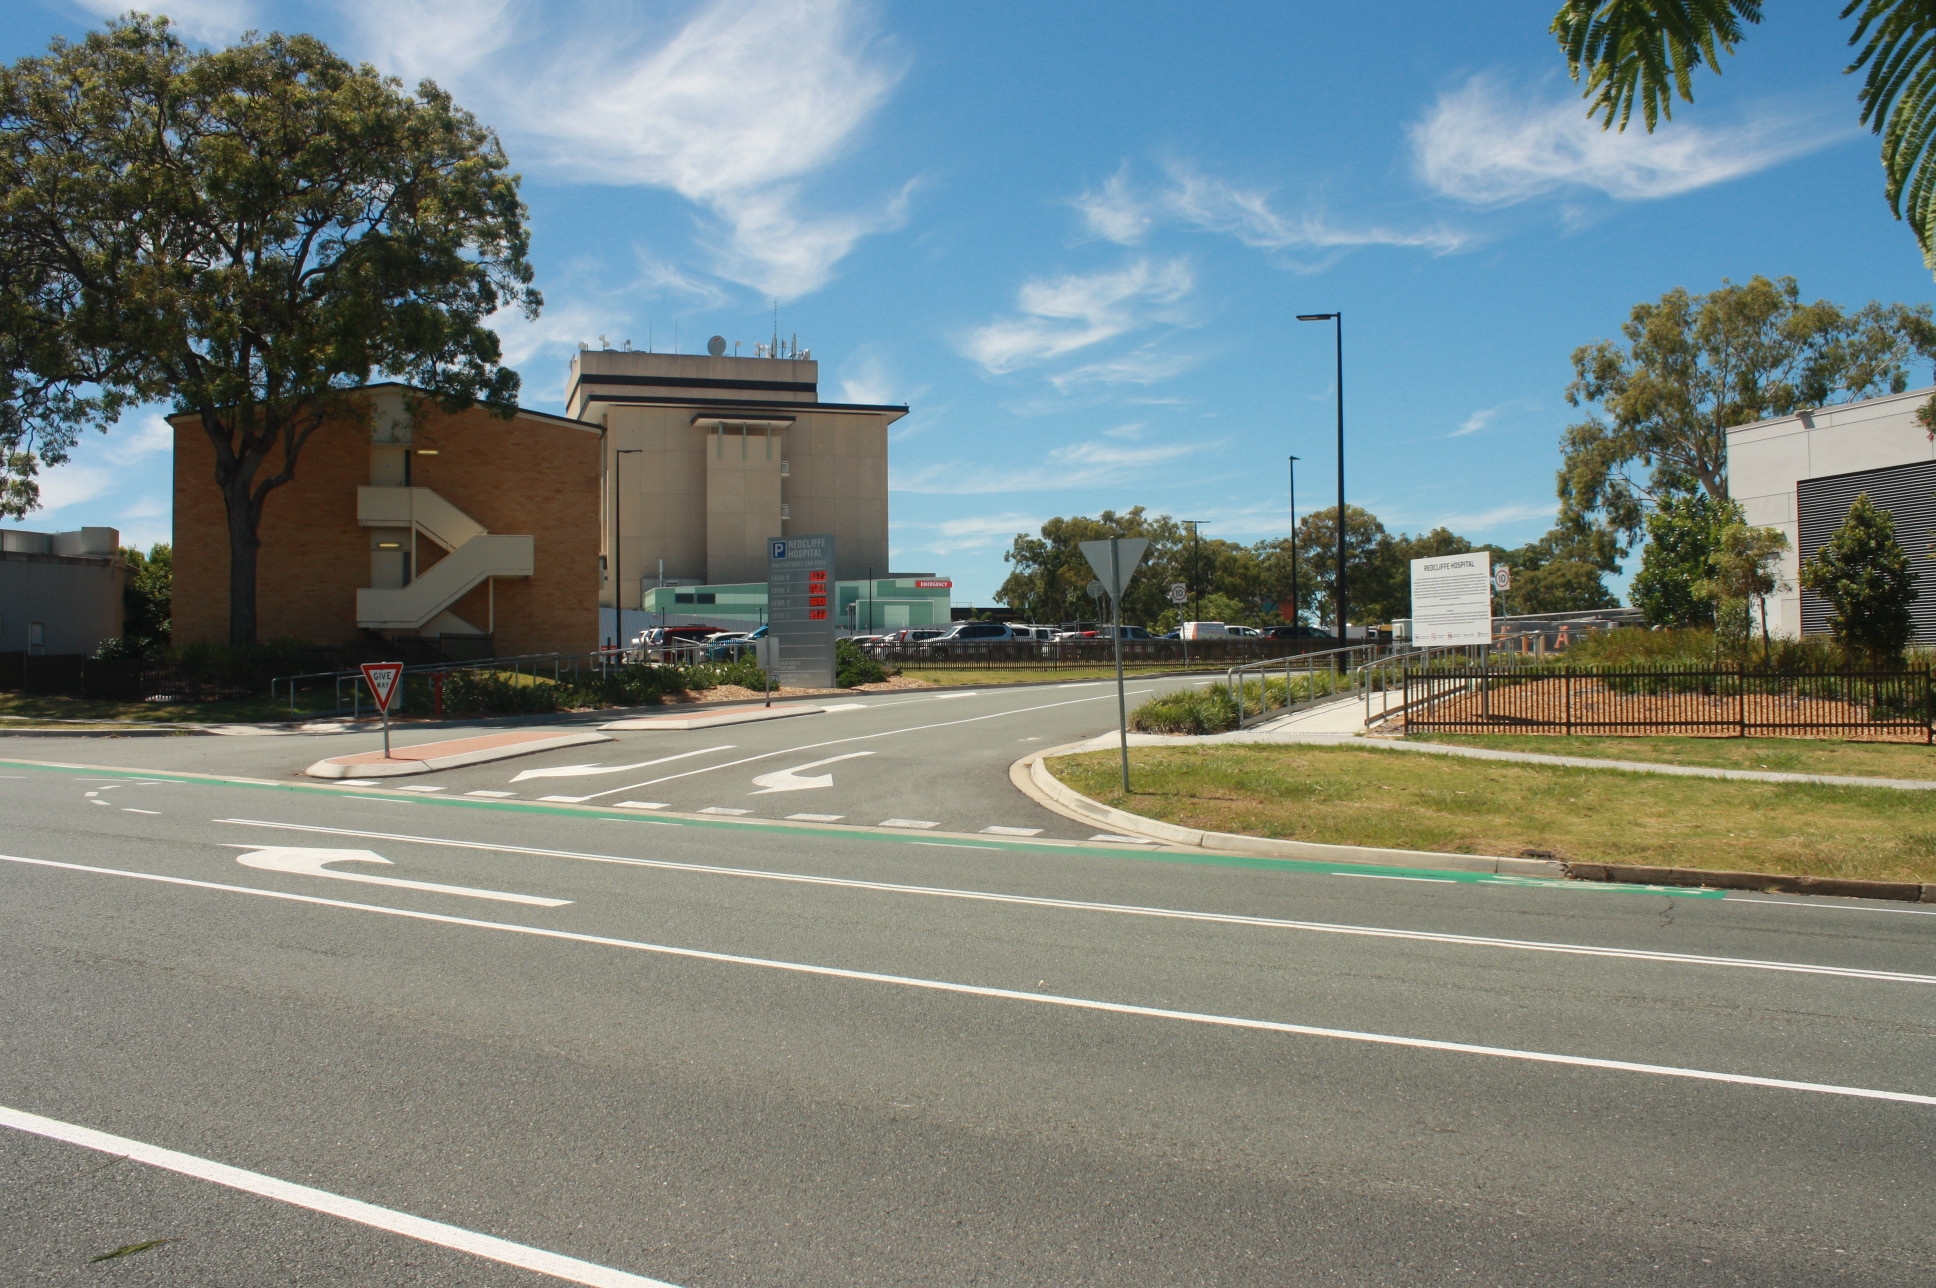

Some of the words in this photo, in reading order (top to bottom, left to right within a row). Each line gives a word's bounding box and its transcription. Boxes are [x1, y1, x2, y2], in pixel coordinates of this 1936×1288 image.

[788, 539, 826, 548] REDCLIFFE
[788, 549, 822, 558] HOSPITAL
[1424, 562, 1450, 571] REDCLIFFE
[1450, 560, 1475, 569] HOSPITAL
[1498, 574, 1506, 583] 10
[1175, 589, 1183, 597] 10
[374, 672, 391, 680] GIVE
